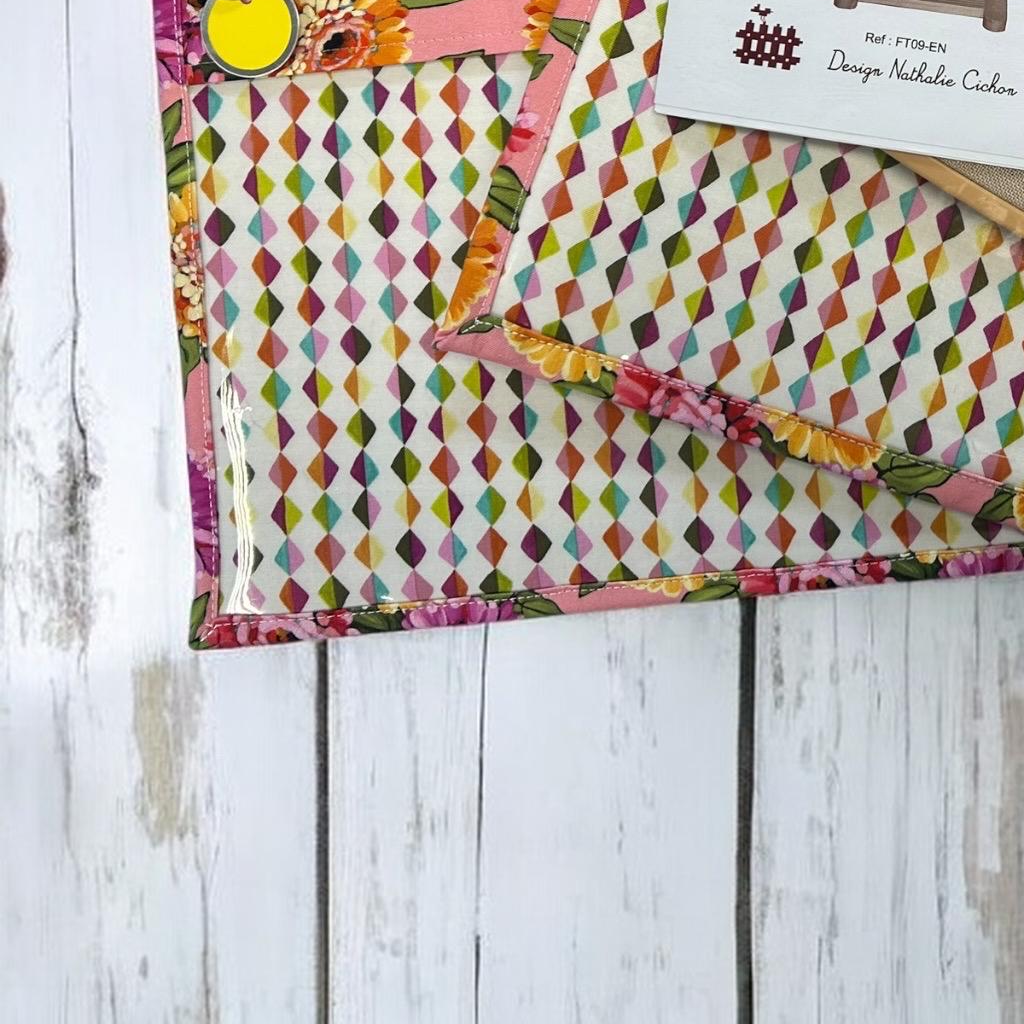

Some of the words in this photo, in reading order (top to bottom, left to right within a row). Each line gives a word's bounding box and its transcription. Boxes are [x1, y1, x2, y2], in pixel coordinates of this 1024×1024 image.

[865, 32, 887, 45] Ref
[895, 36, 947, 54] FT09-EN
[827, 49, 884, 84] Design
[888, 57, 956, 88] Nathalie
[962, 68, 1018, 96] Cichon
